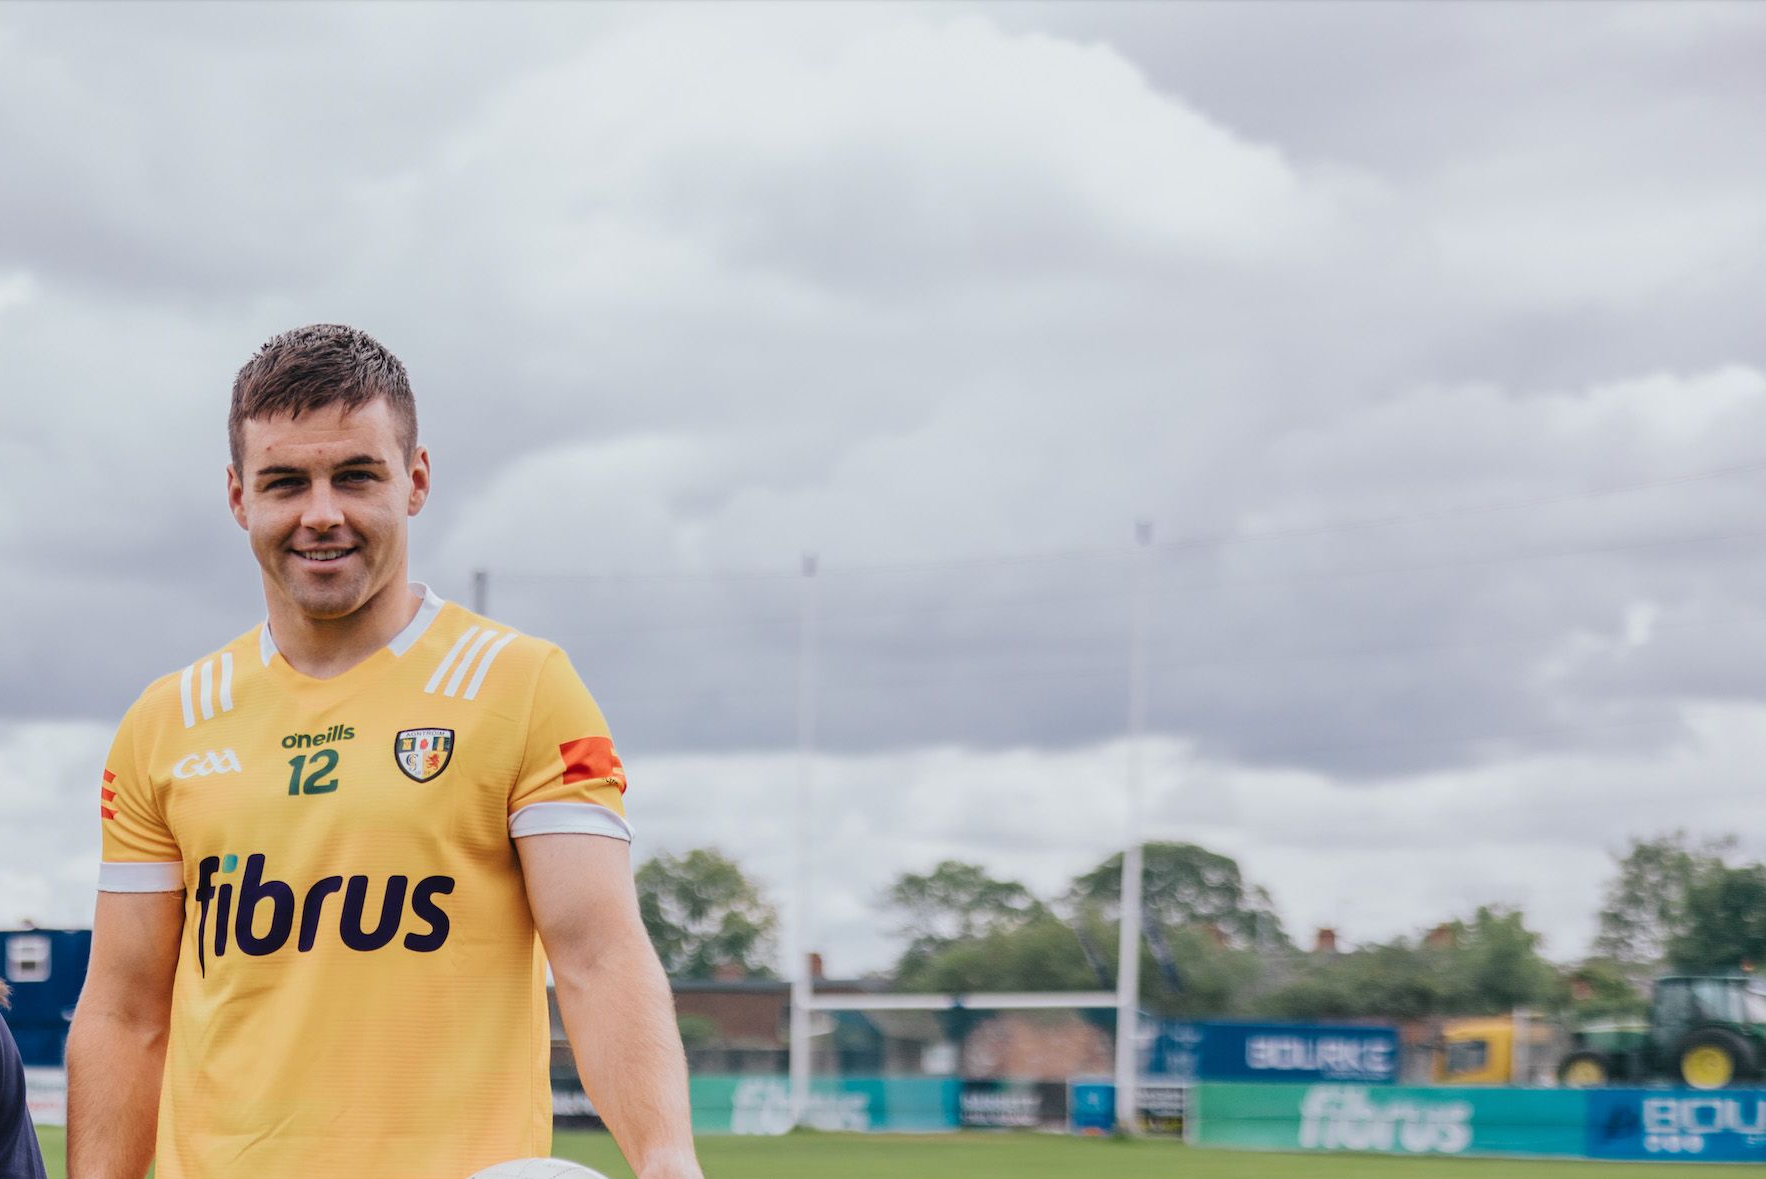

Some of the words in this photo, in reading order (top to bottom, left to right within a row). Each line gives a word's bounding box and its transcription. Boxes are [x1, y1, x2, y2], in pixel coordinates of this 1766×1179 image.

[288, 749, 339, 796] 12
[195, 853, 456, 979] fibrus
[1298, 1085, 1474, 1151] fibrus
